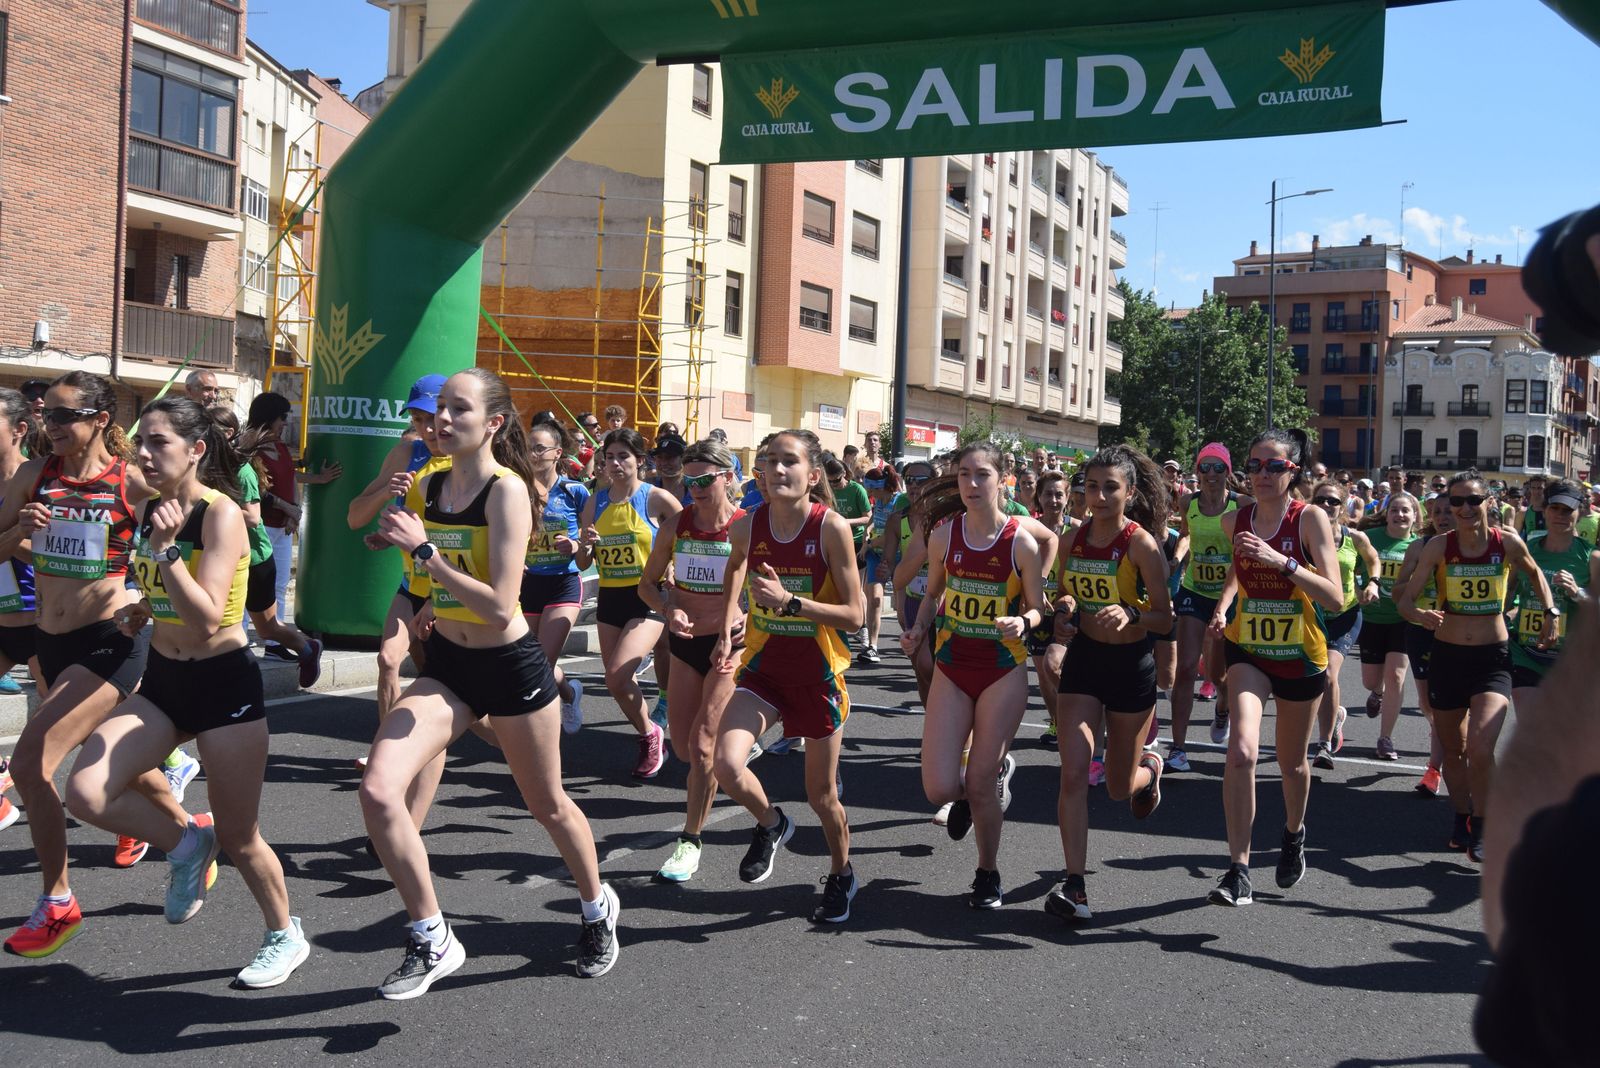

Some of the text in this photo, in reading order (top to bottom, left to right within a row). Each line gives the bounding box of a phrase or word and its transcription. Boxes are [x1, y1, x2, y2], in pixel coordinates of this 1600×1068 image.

[830, 47, 1236, 133] SALIDA
[1258, 85, 1353, 106] CAJA RURAL
[741, 121, 814, 137] CAJA RURAL
[47, 505, 114, 525] ENYA
[44, 535, 86, 557] MARTA
[692, 542, 728, 550] FUNDACION
[601, 547, 635, 566] 223
[71, 563, 101, 573] RURAL
[1079, 561, 1109, 569] FUNDACION
[1196, 564, 1226, 581] 103
[1381, 562, 1402, 577] 11
[138, 562, 168, 593] 24
[686, 566, 716, 582] ELENA
[961, 581, 999, 591] FUNDACION
[1068, 575, 1110, 600] 136
[1460, 579, 1490, 599] 39
[0, 599, 19, 608] URAL
[950, 594, 997, 621] 404
[1257, 601, 1295, 609] FUNDACION
[787, 624, 814, 632] RURAL
[1247, 617, 1294, 642] 107
[1525, 612, 1544, 632] 15
[975, 628, 1000, 636] RURAL
[1275, 648, 1300, 656] RURAL
